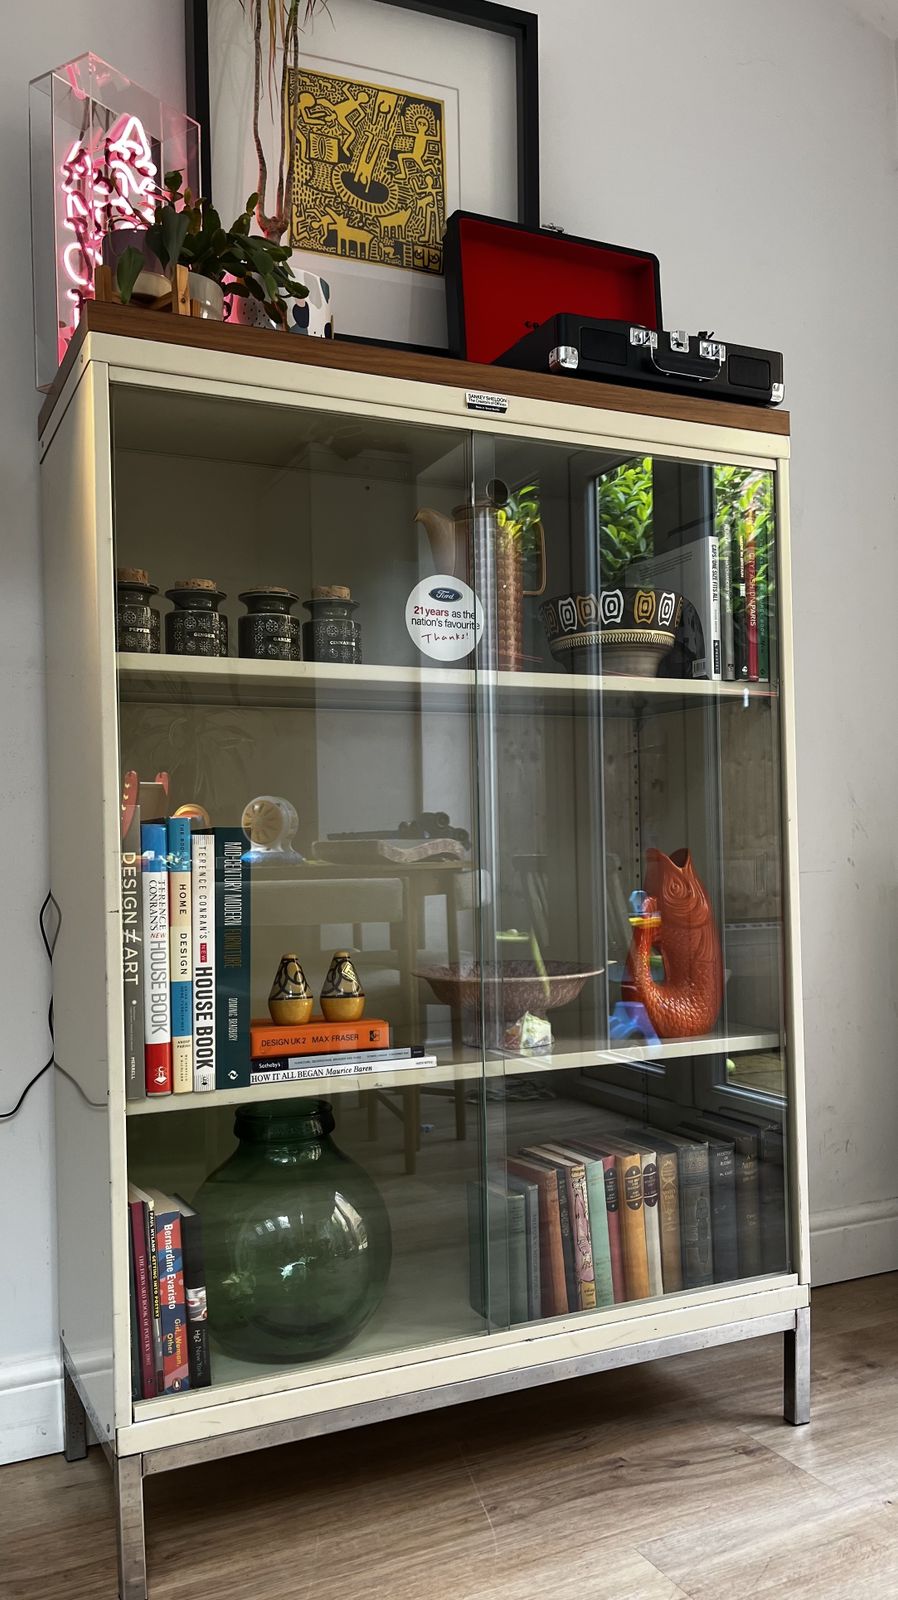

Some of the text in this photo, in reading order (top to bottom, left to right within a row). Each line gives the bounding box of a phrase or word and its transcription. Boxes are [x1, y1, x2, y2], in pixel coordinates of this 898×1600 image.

[411, 618, 443, 628] nation's
[414, 606, 476, 619] 21 years as the
[749, 604, 757, 627] PARIS
[123, 852, 138, 924] DESIGN
[158, 880, 167, 931] TERENCE
[179, 884, 187, 915] HOME
[199, 895, 208, 940] CONRAN'S
[224, 894, 242, 926] MODERN
[124, 947, 139, 986] ART
[150, 940, 168, 1035] HOUSE BOOK
[195, 966, 213, 1022] HOUSE
[196, 1026, 213, 1070] BOOK
[261, 1037, 289, 1048] DESIGN
[289, 1037, 301, 1046] UK
[311, 1036, 330, 1044] MAX
[331, 1033, 359, 1043] FRASER
[251, 1065, 373, 1083] HOW IT ALL BEGAN Maurice Baren
[258, 1061, 281, 1070] Sotheby's
[164, 1223, 177, 1310] Bernardine Evaristo
